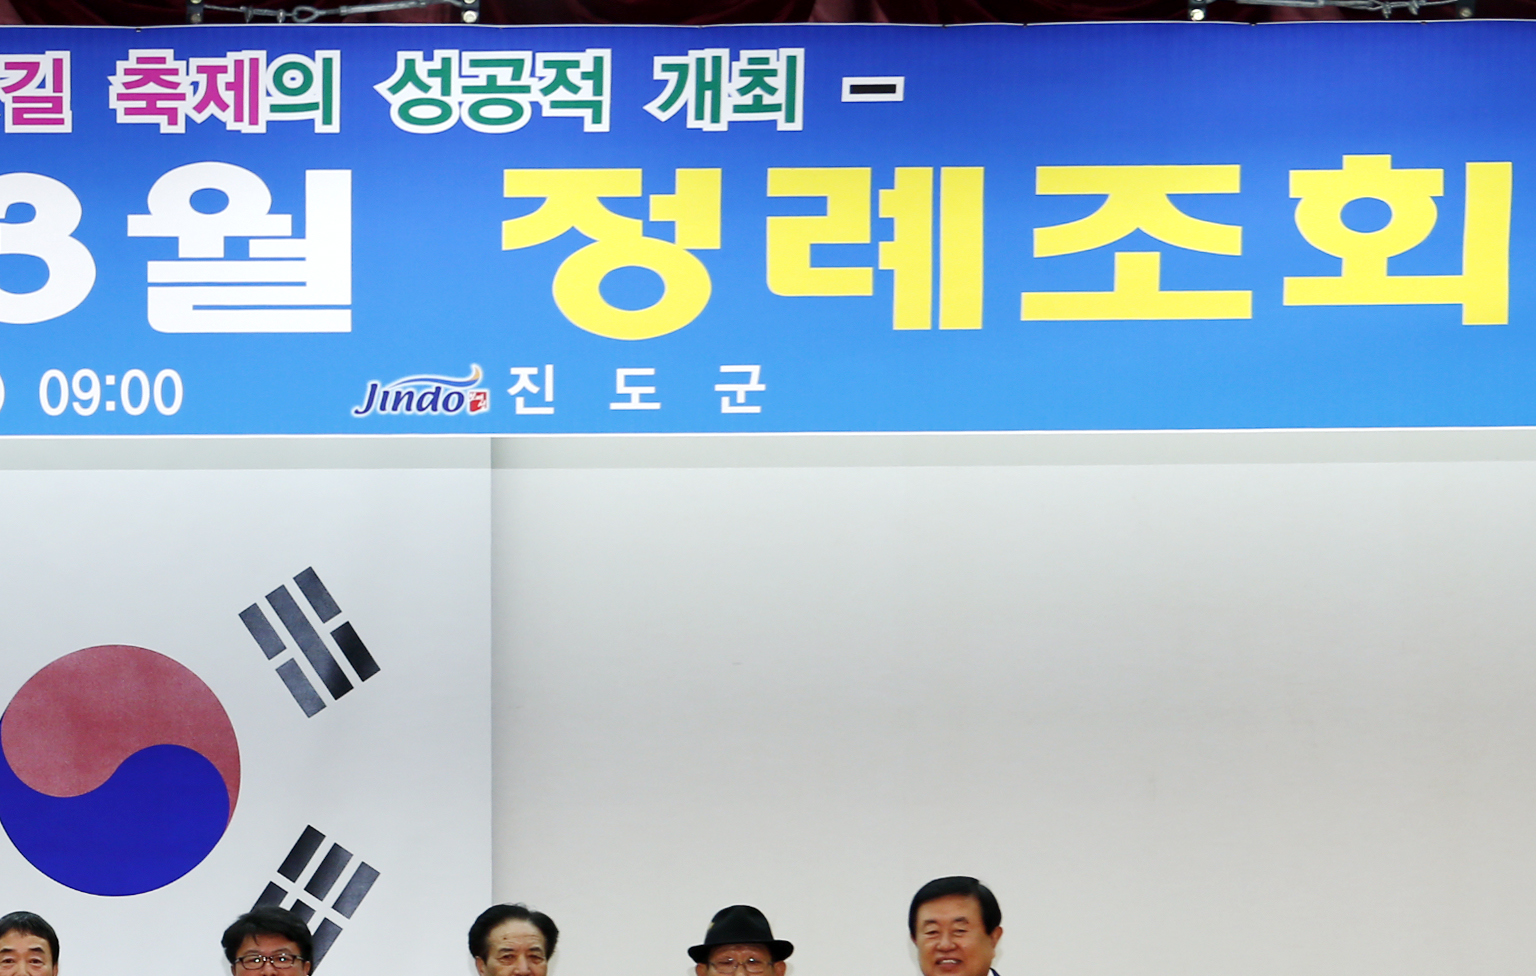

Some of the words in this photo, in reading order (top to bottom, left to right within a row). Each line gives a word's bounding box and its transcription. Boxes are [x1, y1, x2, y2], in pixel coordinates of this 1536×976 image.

[108, 49, 340, 133] 축제의
[374, 49, 611, 133] 성공적
[643, 48, 804, 131] 개최
[39, 369, 183, 416] 09:00
[353, 382, 464, 415] Jindo
